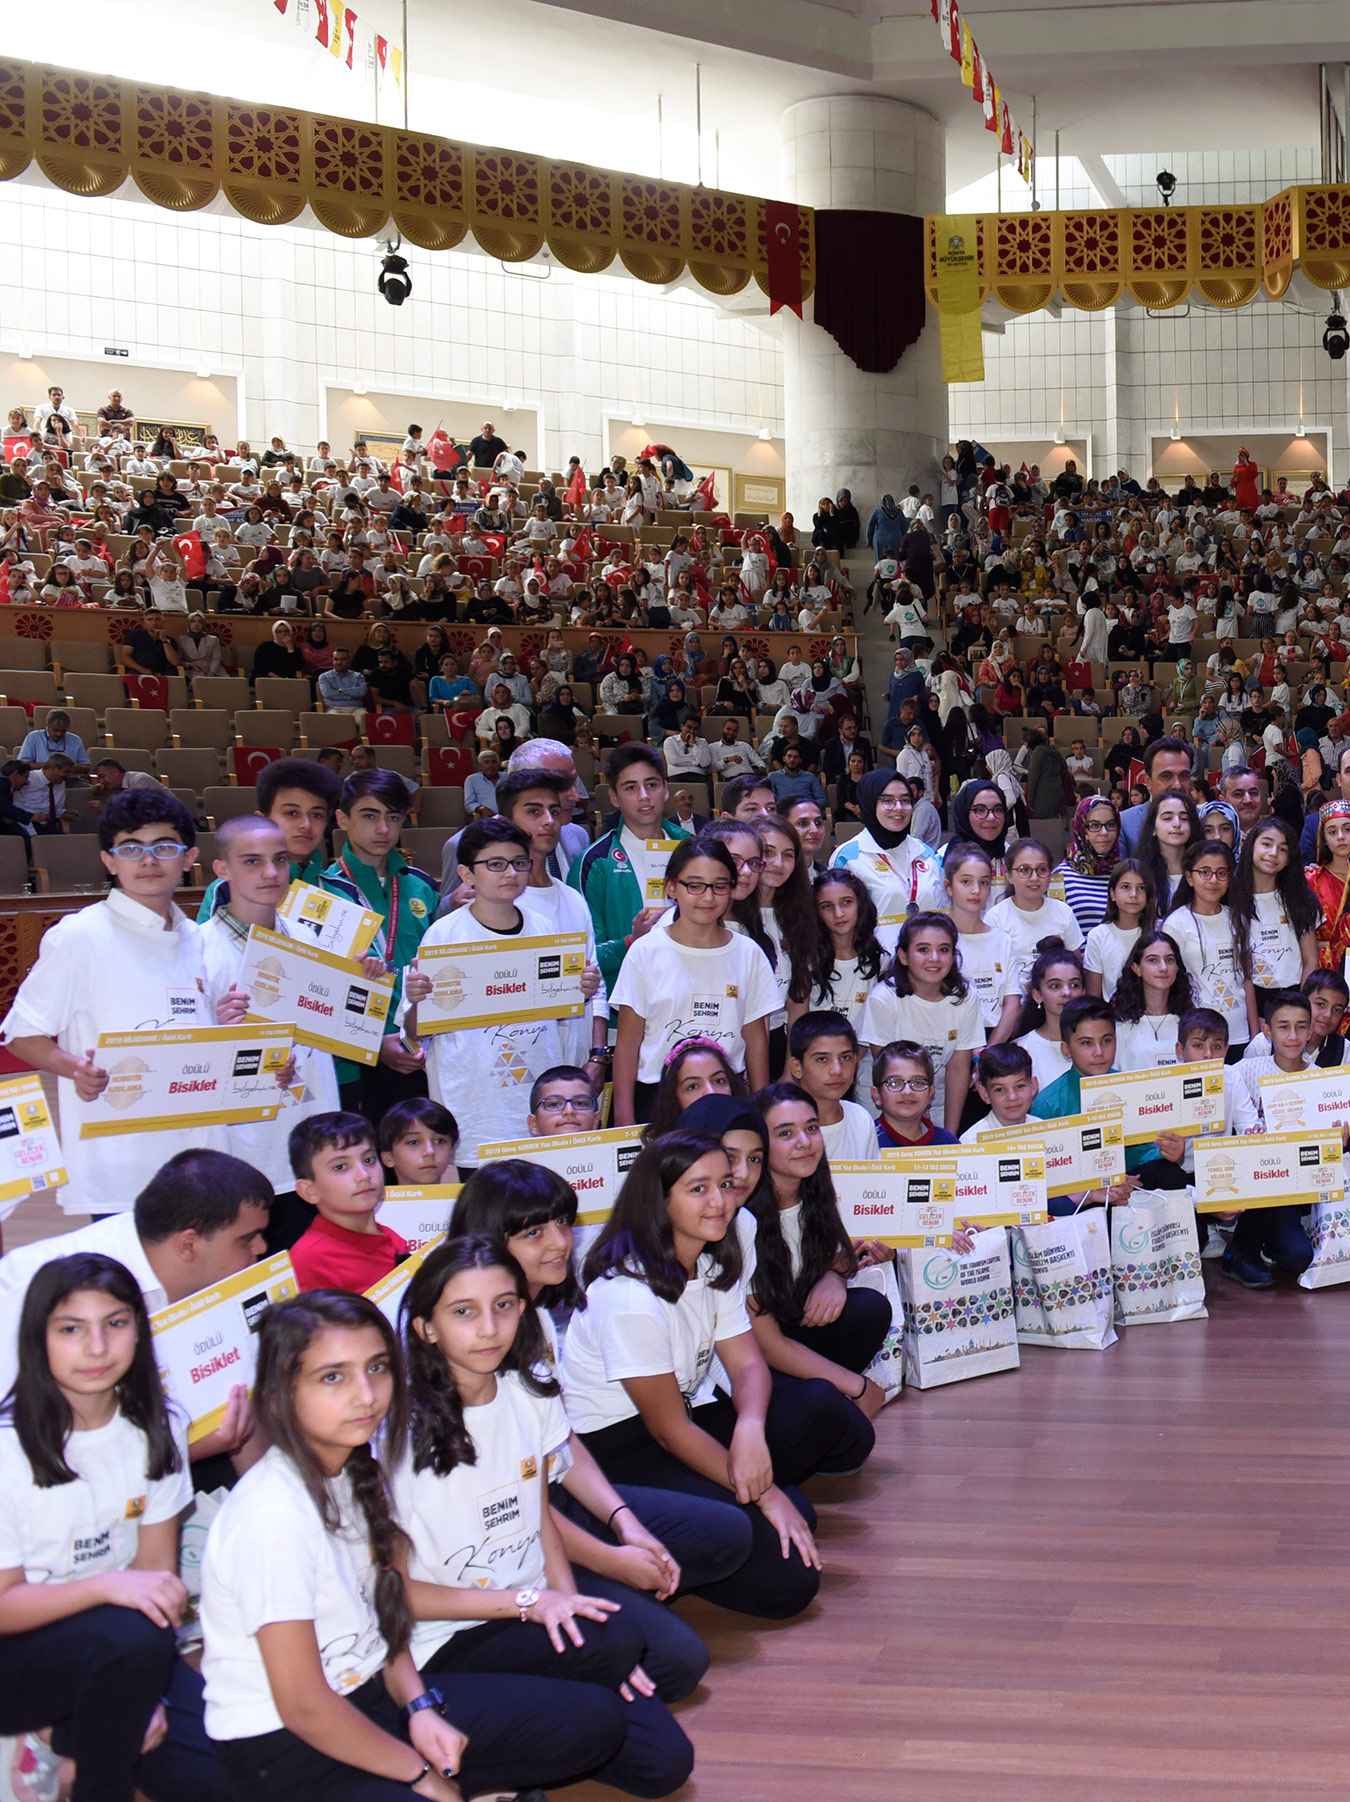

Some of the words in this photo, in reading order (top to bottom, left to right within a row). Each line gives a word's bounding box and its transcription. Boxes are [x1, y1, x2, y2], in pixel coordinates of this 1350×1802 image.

[486, 982, 526, 996] Bisiklet
[298, 995, 334, 1016] Bisiklet
[169, 1079, 217, 1094] Bisiklet
[1138, 1103, 1173, 1116] Bisiklet
[1047, 1156, 1072, 1168] siklet
[1260, 1158, 1281, 1166] ÖDÜLÜ
[566, 1163, 593, 1175] ÖDÜLÜ
[1254, 1168, 1289, 1179] Bisiklet
[863, 1190, 886, 1199] ÖDÜLÜ
[955, 1185, 987, 1196] isiklet
[853, 1205, 894, 1215] Bisiklet
[194, 1331, 223, 1356] ÖDÜLÜ
[190, 1347, 241, 1384] Bisiklet
